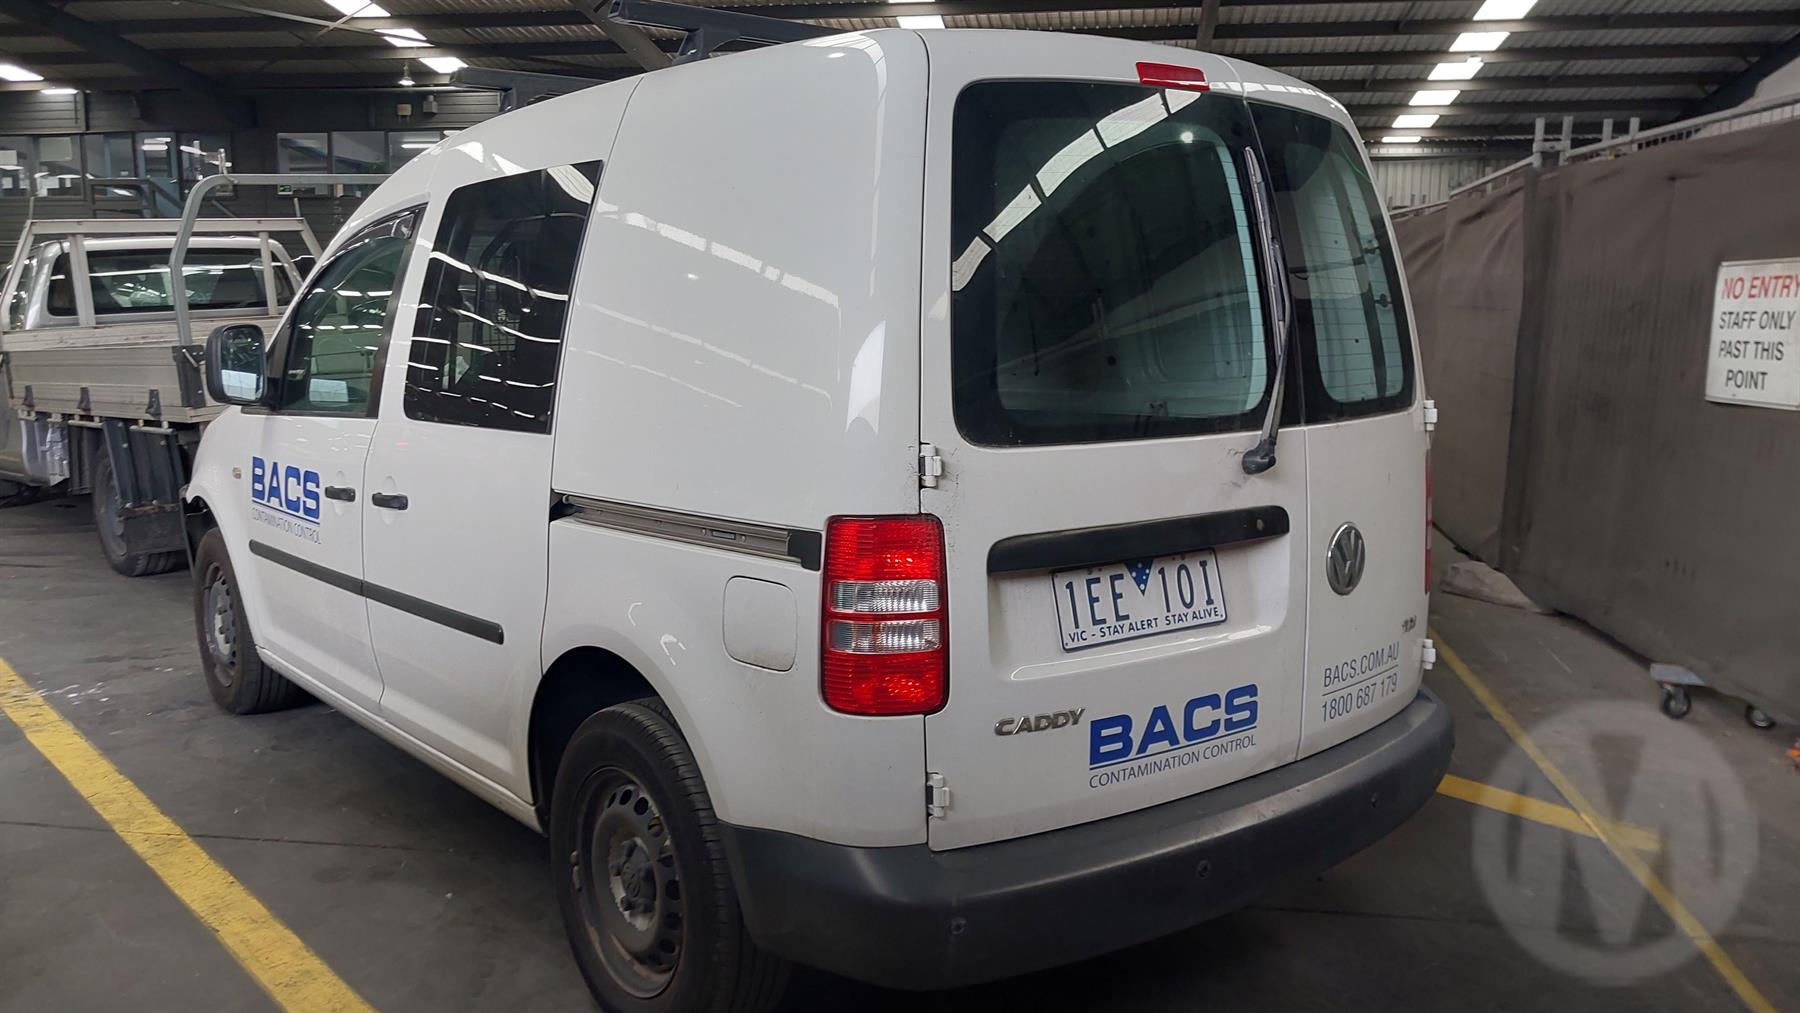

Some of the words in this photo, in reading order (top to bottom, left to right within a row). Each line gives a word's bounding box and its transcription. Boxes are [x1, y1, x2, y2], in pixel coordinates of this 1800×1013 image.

[1722, 277, 1745, 299] NO
[1719, 311, 1757, 330] STAFF
[1759, 310, 1796, 330] ONLY
[1718, 340, 1750, 359] PAST
[1753, 341, 1784, 361] THIS
[1725, 369, 1768, 390] POINT
[252, 456, 320, 520] BACS
[1065, 573, 1130, 629] 1EE
[1069, 630, 1088, 643] VIC
[1100, 623, 1126, 638] STAY
[1128, 618, 1159, 633] ALERT
[1165, 612, 1189, 626] STAY
[1192, 607, 1219, 621] ALIVE
[1323, 641, 1400, 688] BACS.COM.AU
[1322, 693, 1353, 722] 1800
[1356, 683, 1377, 709] 687
[1381, 672, 1398, 698] 179
[994, 708, 1086, 736] CADDY
[1089, 683, 1259, 766] BACS
[1089, 751, 1200, 789] CONTAMINATION
[1202, 735, 1257, 761] CONTROL
